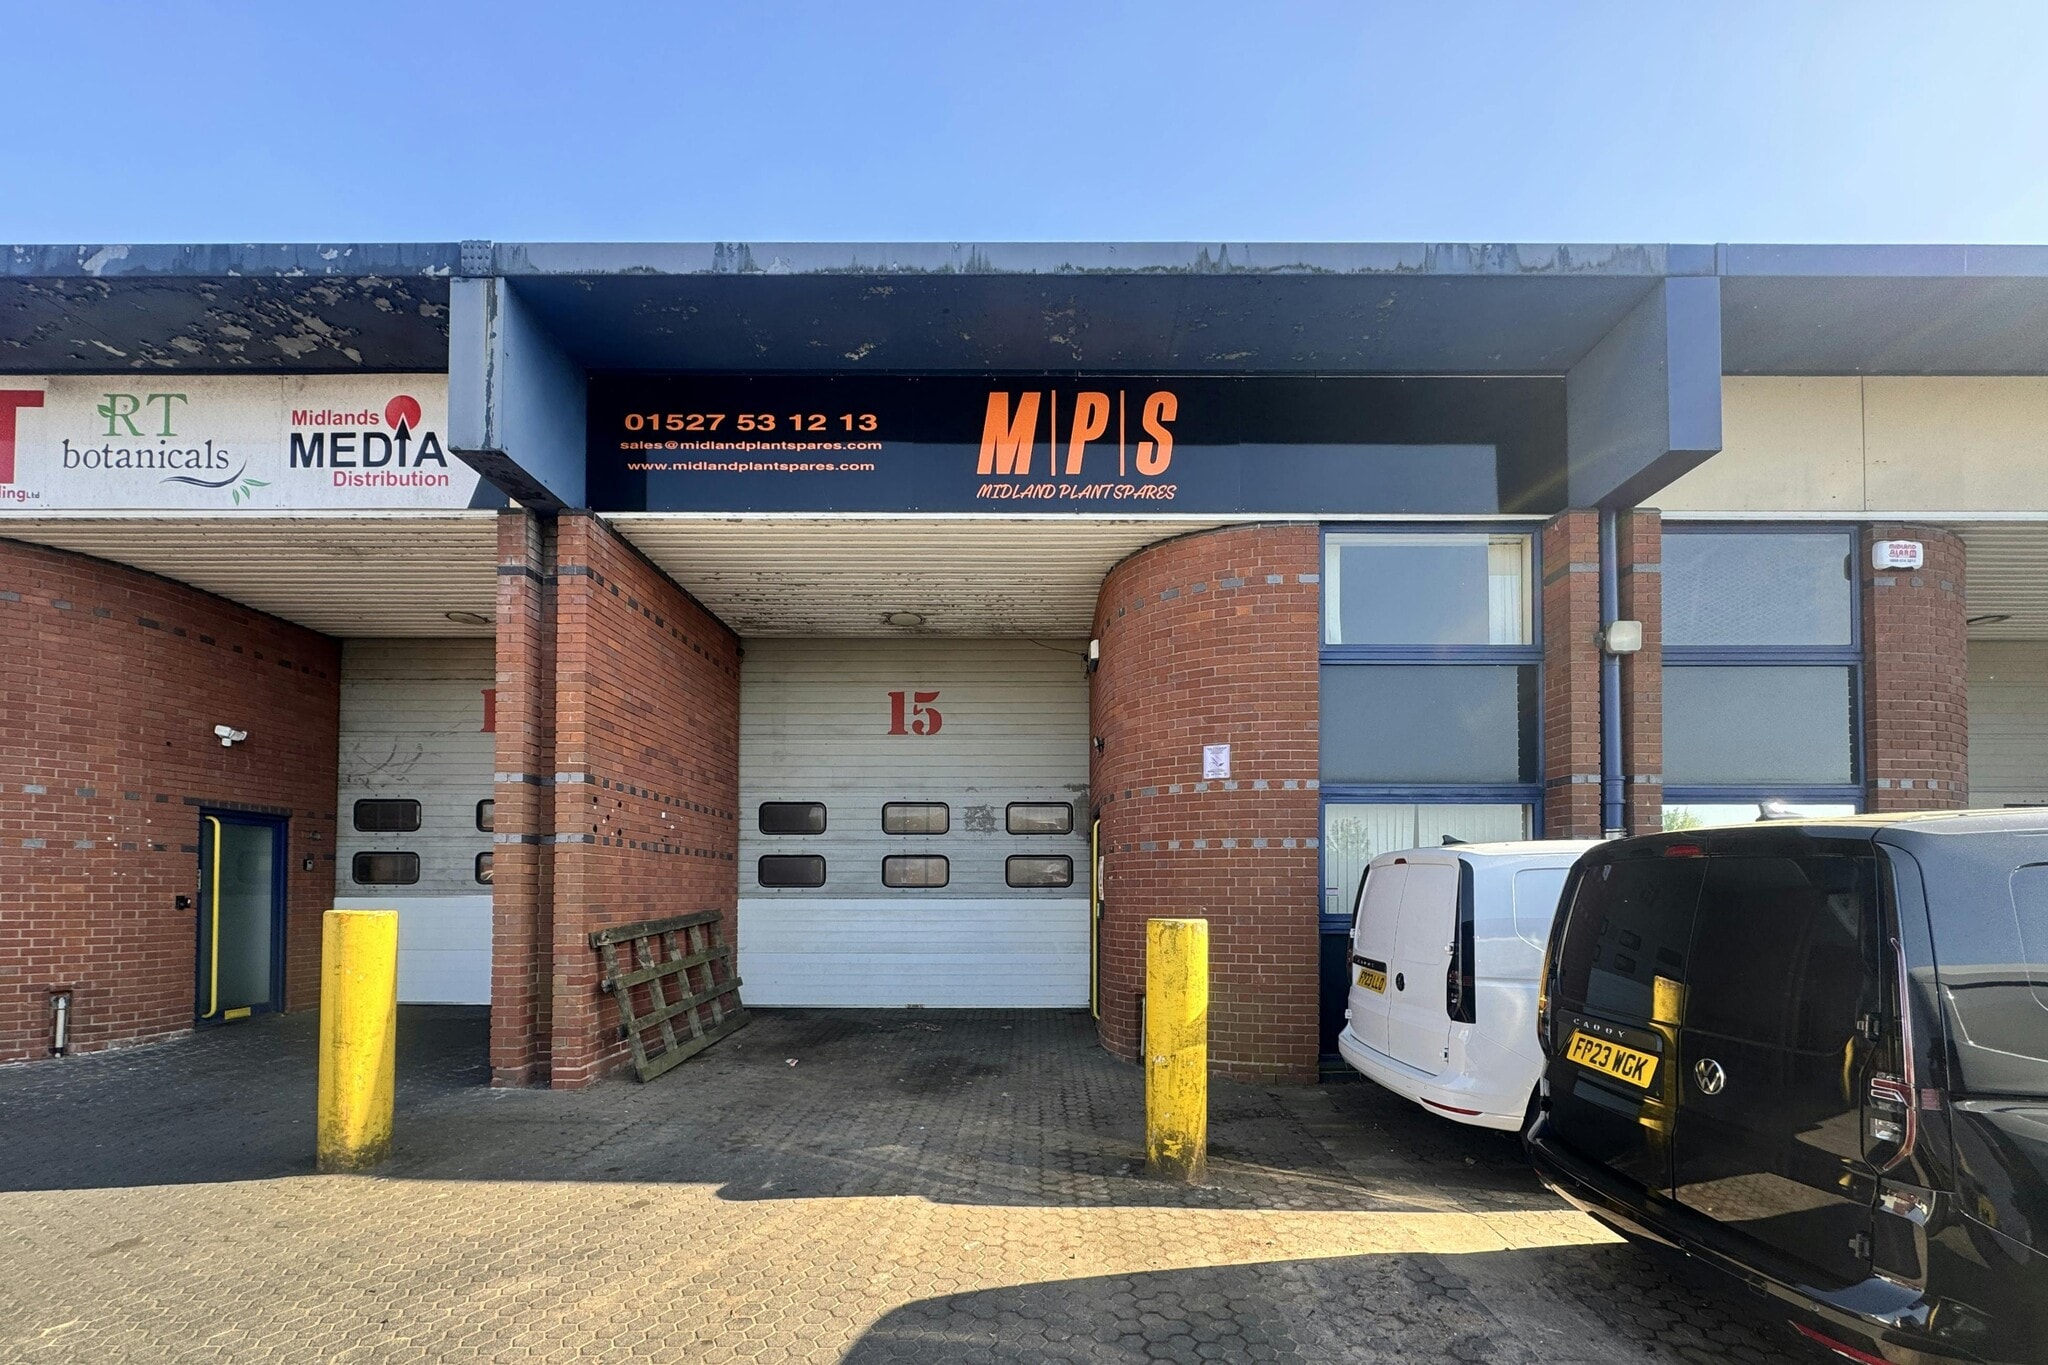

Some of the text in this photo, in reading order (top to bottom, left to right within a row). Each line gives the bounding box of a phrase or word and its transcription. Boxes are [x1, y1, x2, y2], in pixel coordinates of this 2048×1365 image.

[100, 393, 188, 437] RT
[291, 409, 380, 426] Midlands
[624, 413, 878, 431] 01527 53 12 13
[290, 419, 448, 468] MEDIA
[620, 440, 883, 452] sales@midlandplantspares.com
[62, 439, 230, 470] botanicals
[627, 461, 875, 473] www.midlandplantspares.com
[333, 471, 449, 487] Distribution
[0, 486, 26, 502] ing
[976, 483, 1178, 500] MIDLAND PLANT SPARES
[888, 691, 942, 735] 15
[1573, 1018, 1626, 1038] CADDY
[1572, 1037, 1649, 1081] FP23 WGK
